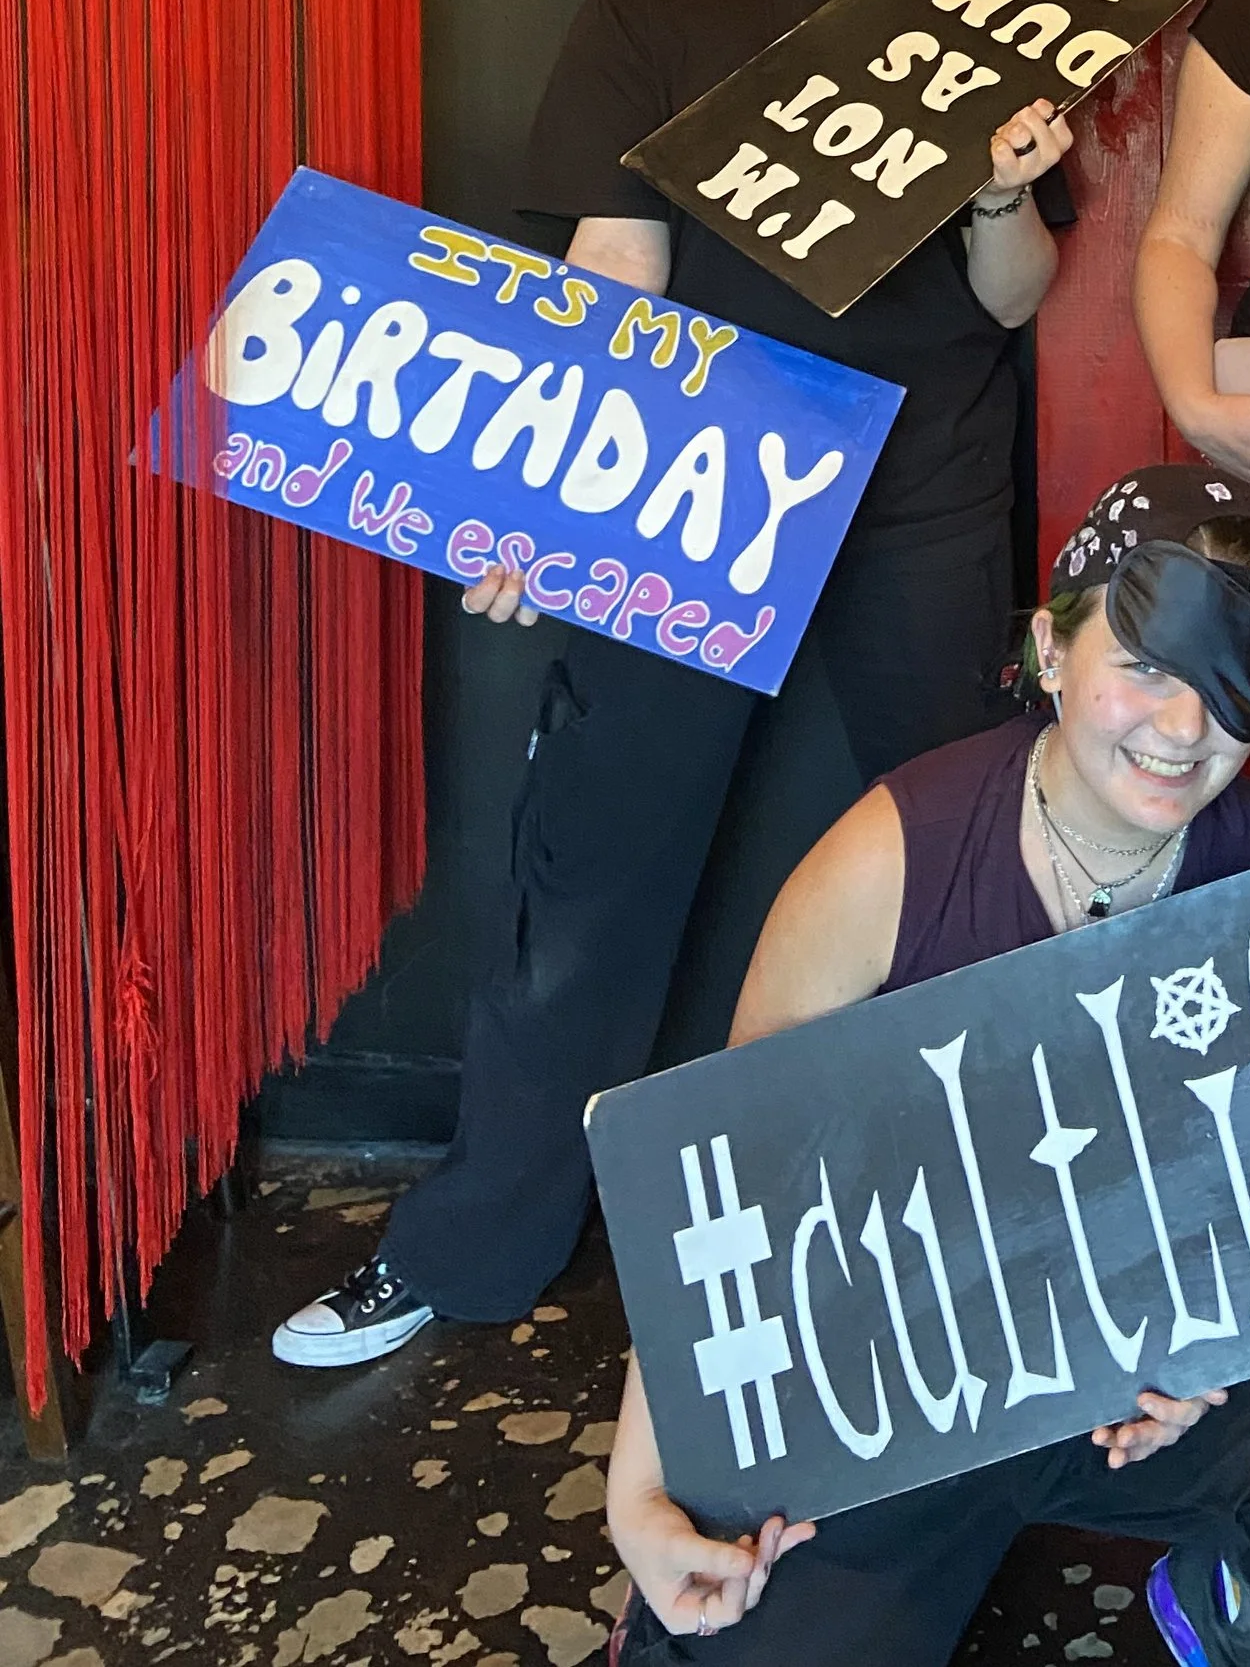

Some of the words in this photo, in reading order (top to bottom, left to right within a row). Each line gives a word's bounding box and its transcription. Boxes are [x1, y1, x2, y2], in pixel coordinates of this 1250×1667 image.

[867, 31, 1001, 112] AS
[763, 74, 948, 198] NOT
[695, 142, 856, 259] I'M
[408, 225, 599, 326] IT'S
[608, 297, 739, 397] MY
[212, 431, 351, 507] and
